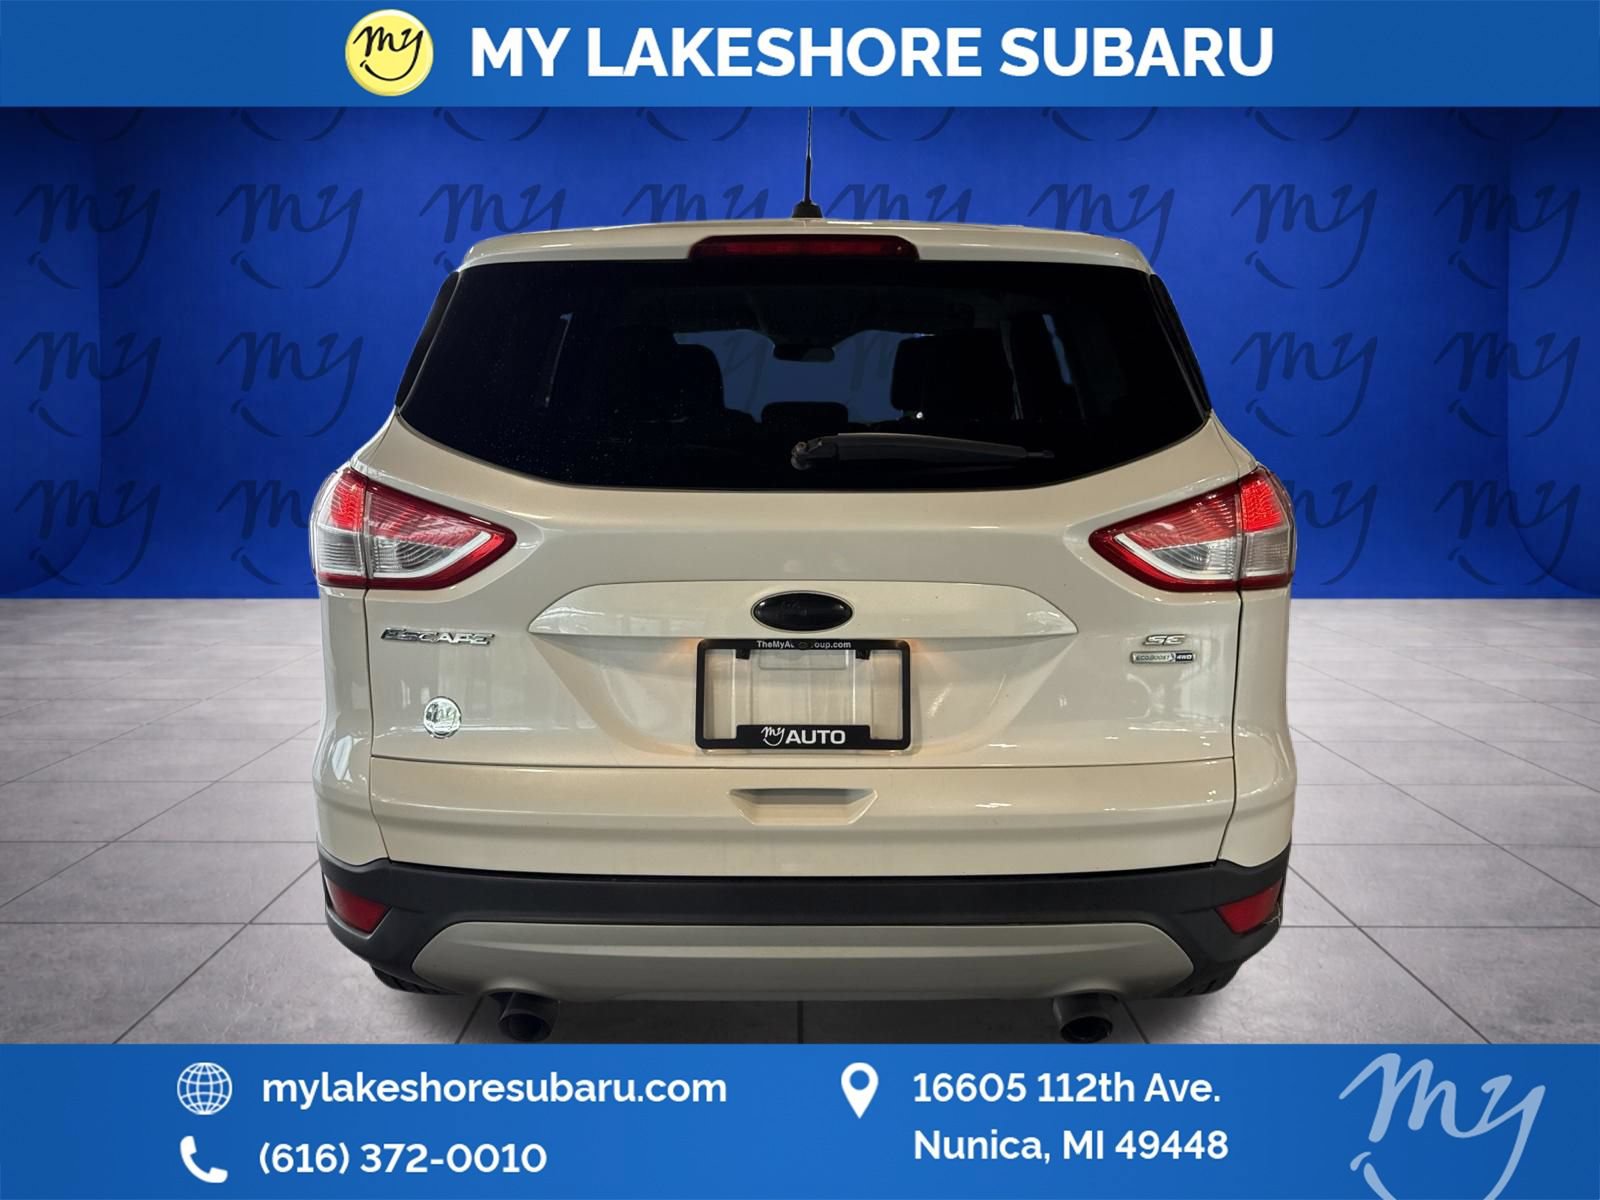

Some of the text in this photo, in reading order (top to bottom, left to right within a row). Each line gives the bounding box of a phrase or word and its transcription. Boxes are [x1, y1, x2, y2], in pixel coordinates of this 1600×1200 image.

[381, 627, 495, 645] ESCAPE
[1143, 634, 1186, 646] SE
[761, 726, 846, 747] my AUTO
